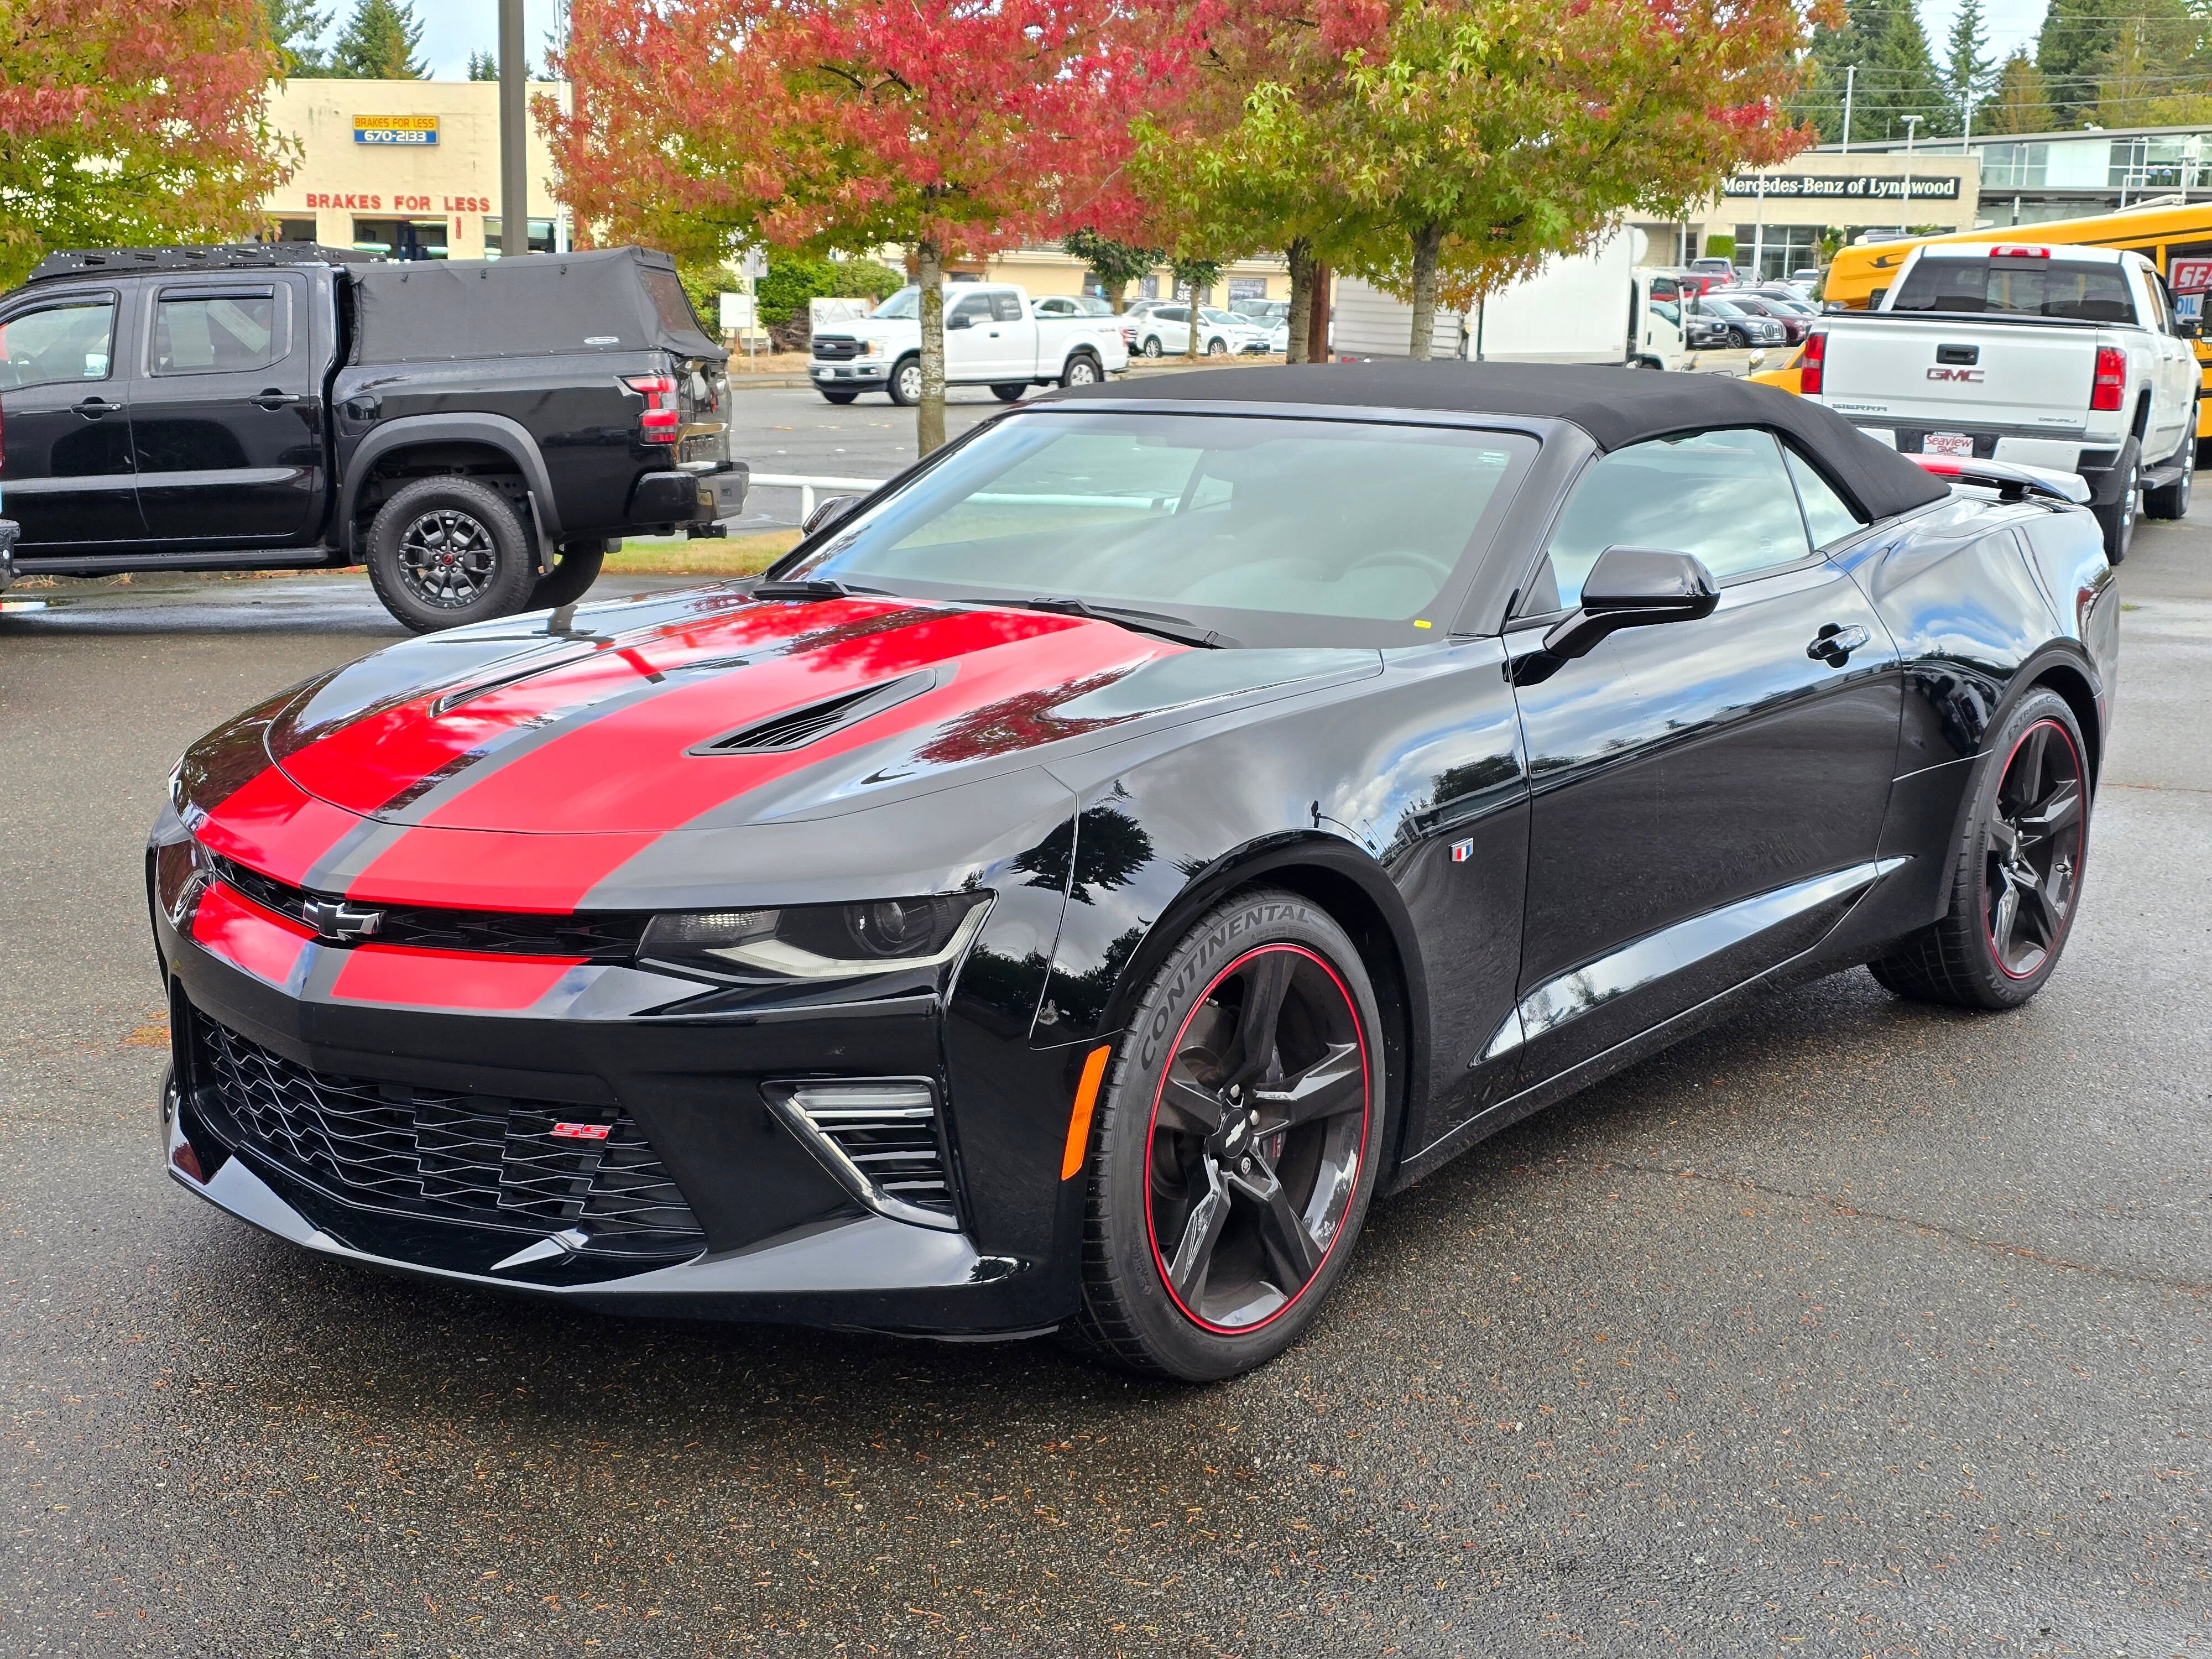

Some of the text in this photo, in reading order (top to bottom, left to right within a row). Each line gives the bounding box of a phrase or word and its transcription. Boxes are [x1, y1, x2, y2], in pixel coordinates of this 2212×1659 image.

[355, 118, 434, 128] BRAKES FOR LESS
[364, 130, 426, 142] 670-2133
[1721, 177, 1955, 197] Mercedes-Benz of Lynnwood
[306, 194, 490, 212] BRAKES FOR LESS
[2176, 297, 2197, 315] OIL
[1927, 367, 1985, 383] GMC
[1832, 403, 1887, 411] SIERRA
[1925, 435, 1973, 447] Seaview
[1141, 905, 1310, 1071] CONTINENTAL
[550, 1123, 612, 1139] SS
